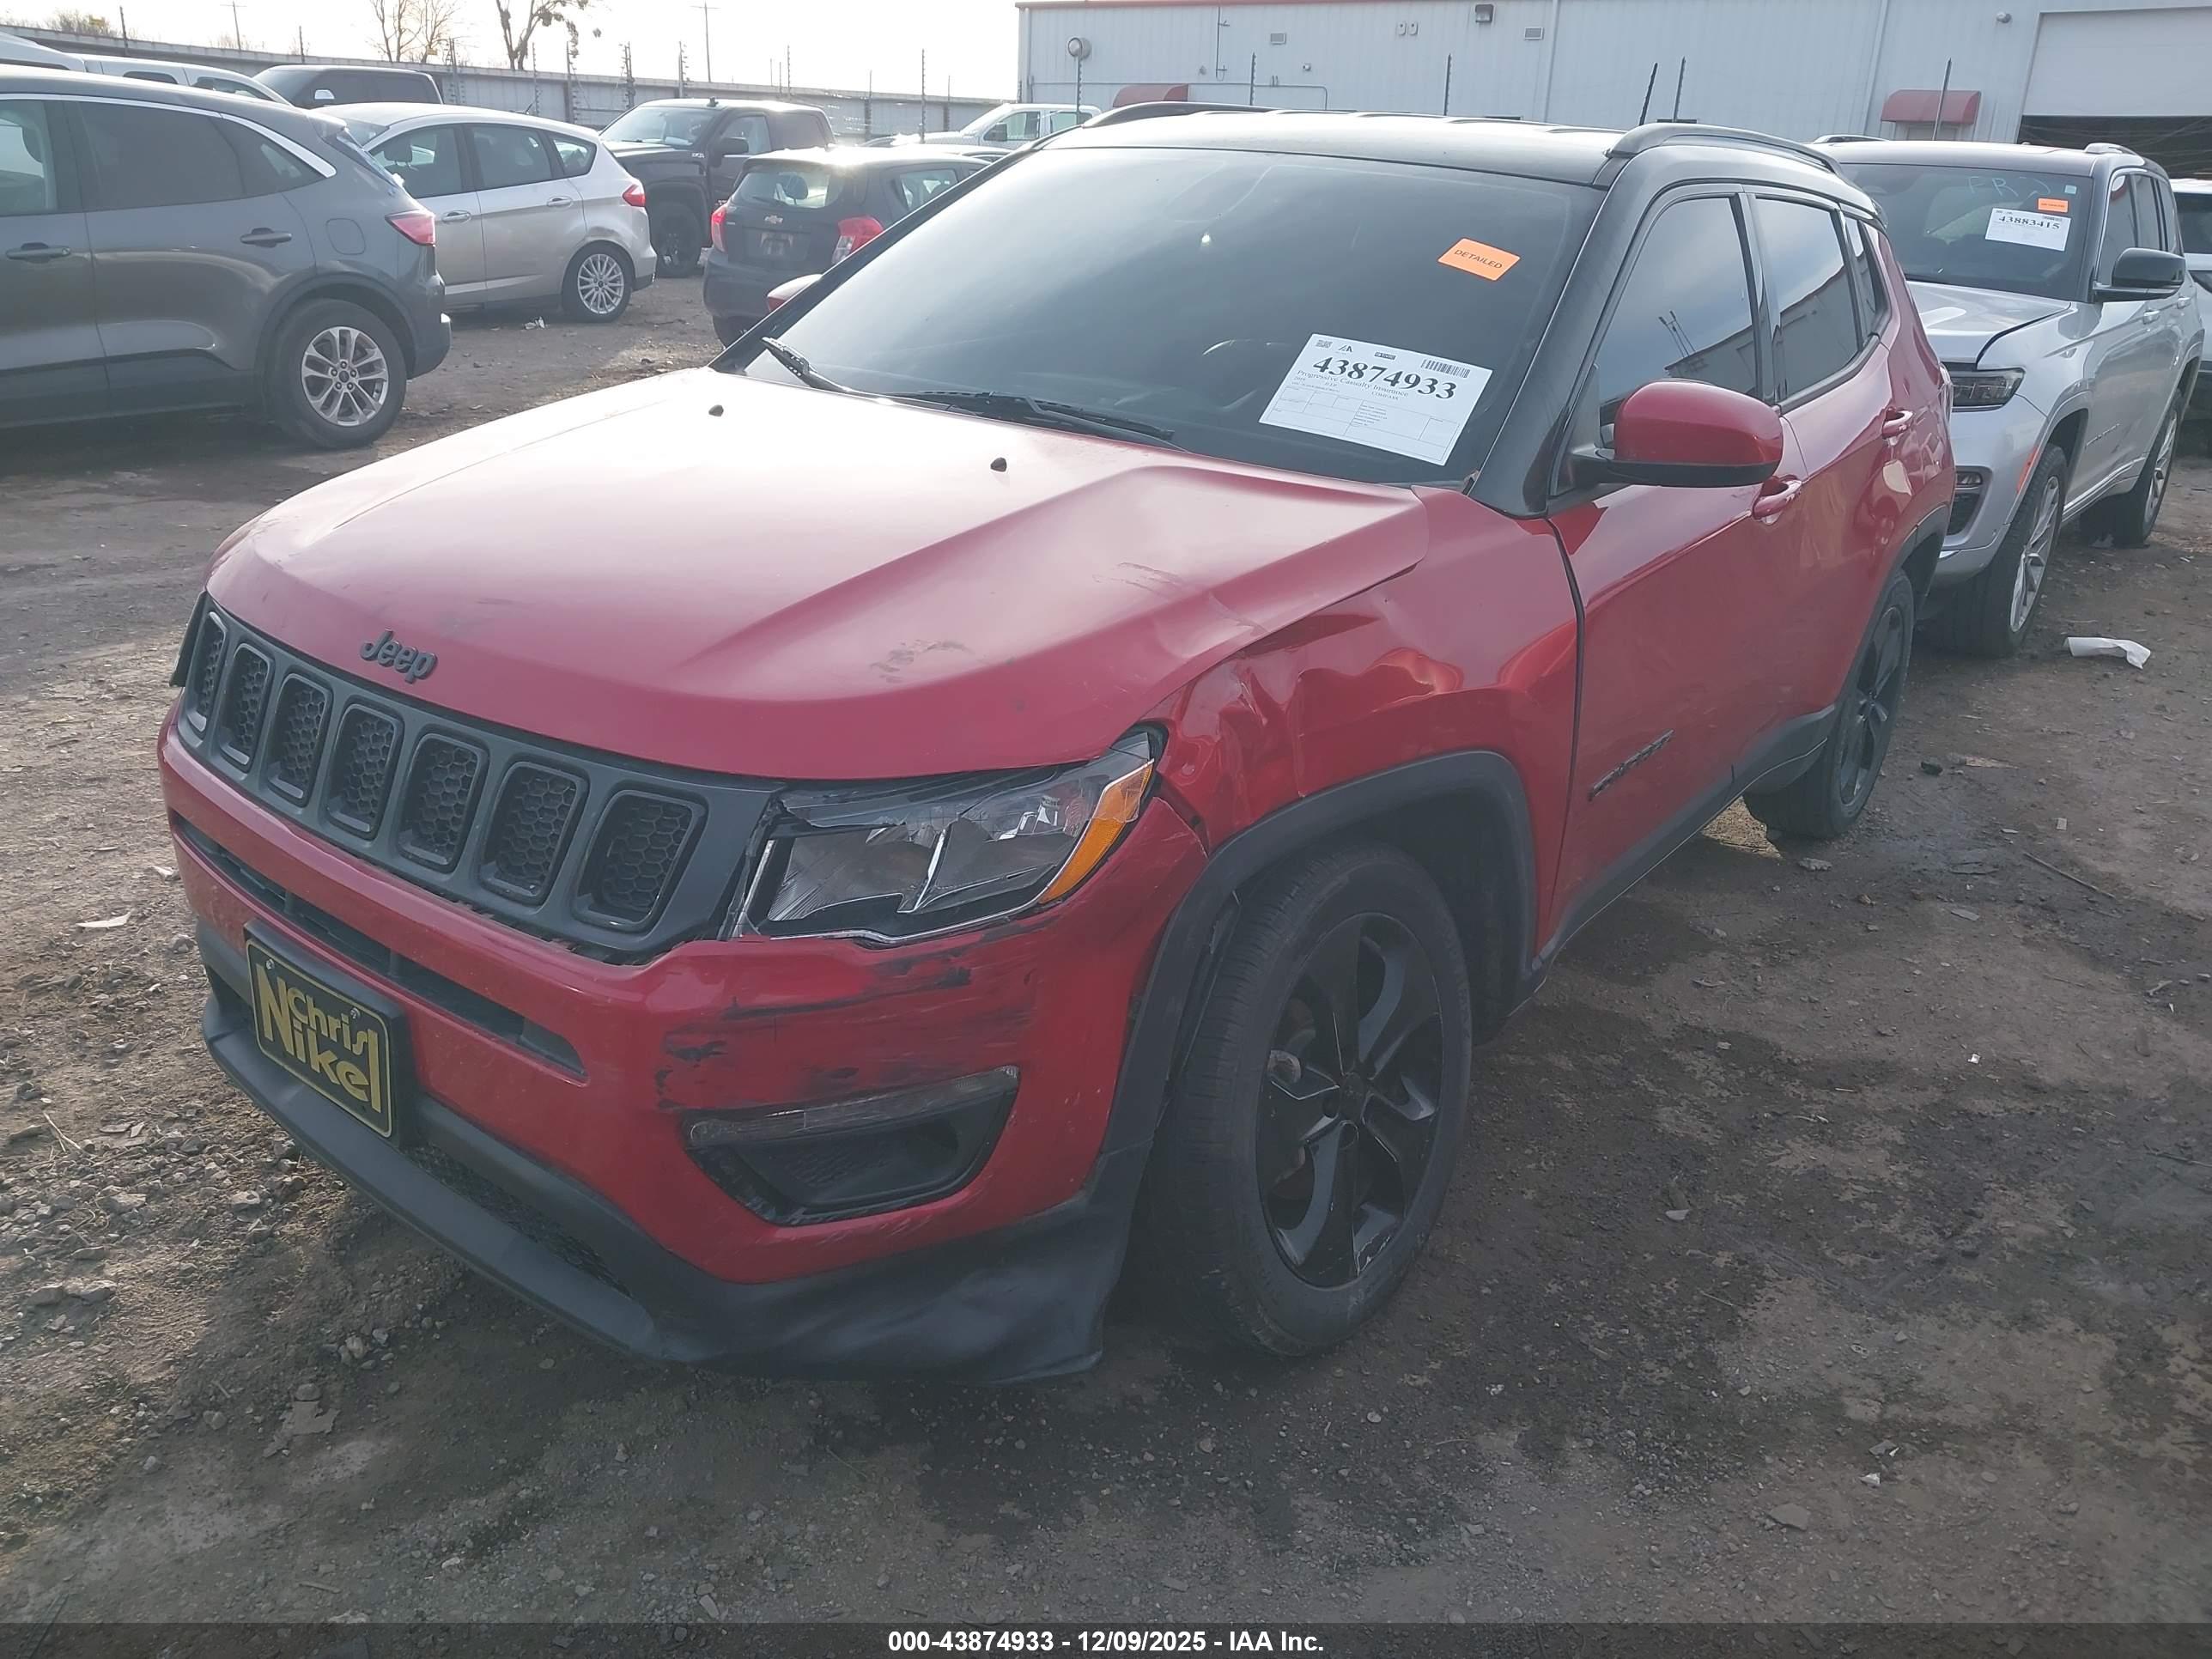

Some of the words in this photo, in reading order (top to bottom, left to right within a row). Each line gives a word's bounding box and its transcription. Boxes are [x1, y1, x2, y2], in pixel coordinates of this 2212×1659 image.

[1998, 216, 2061, 230] 43883415
[1454, 249, 1504, 270] DETAILED
[1297, 370, 1339, 383] Progressive
[1340, 378, 1370, 390] Casualty
[1373, 384, 1409, 398] Insurance
[1312, 356, 1457, 399] 43874933
[360, 628, 438, 684] Jeep
[255, 963, 382, 1114] Nikel
[287, 987, 368, 1056] Chris
